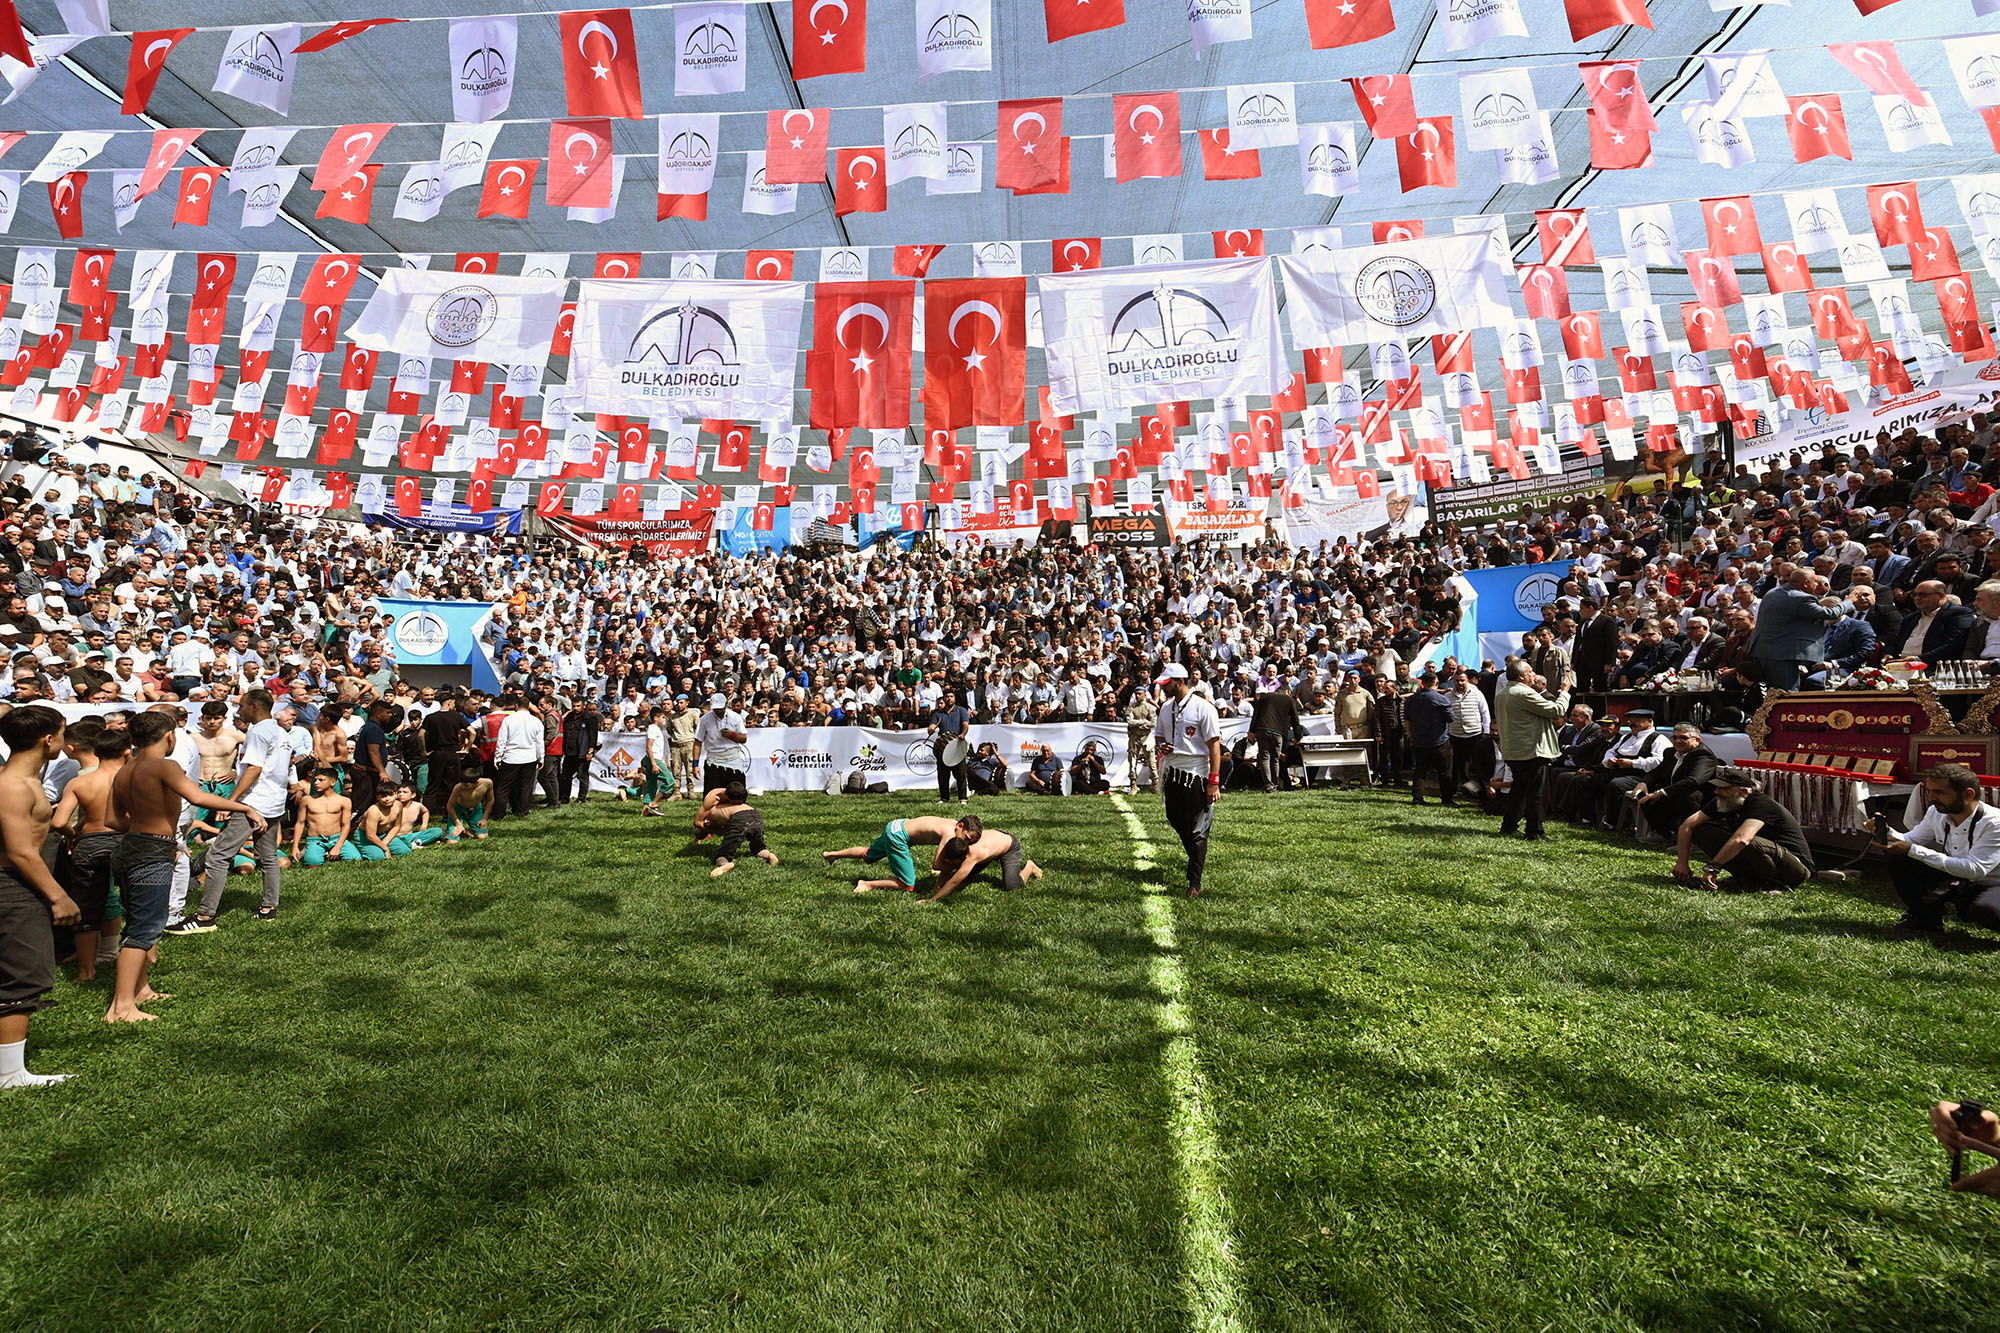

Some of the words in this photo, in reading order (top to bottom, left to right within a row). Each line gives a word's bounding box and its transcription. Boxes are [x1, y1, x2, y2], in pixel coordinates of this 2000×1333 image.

[1108, 349, 1238, 376] DULKADİROĞLU
[621, 370, 740, 387] DULKADİROĞLU
[1134, 368, 1216, 384] BELEDİYESİ
[642, 386, 716, 397] BELEDİYESİ
[1436, 503, 1518, 523] BAŞARILAR
[596, 519, 616, 530] TÜM
[617, 519, 693, 531] SPORCULARIMIZA,
[1092, 518, 1156, 531] MEGA
[1093, 531, 1156, 542] GROSS
[858, 764, 888, 772] Park
